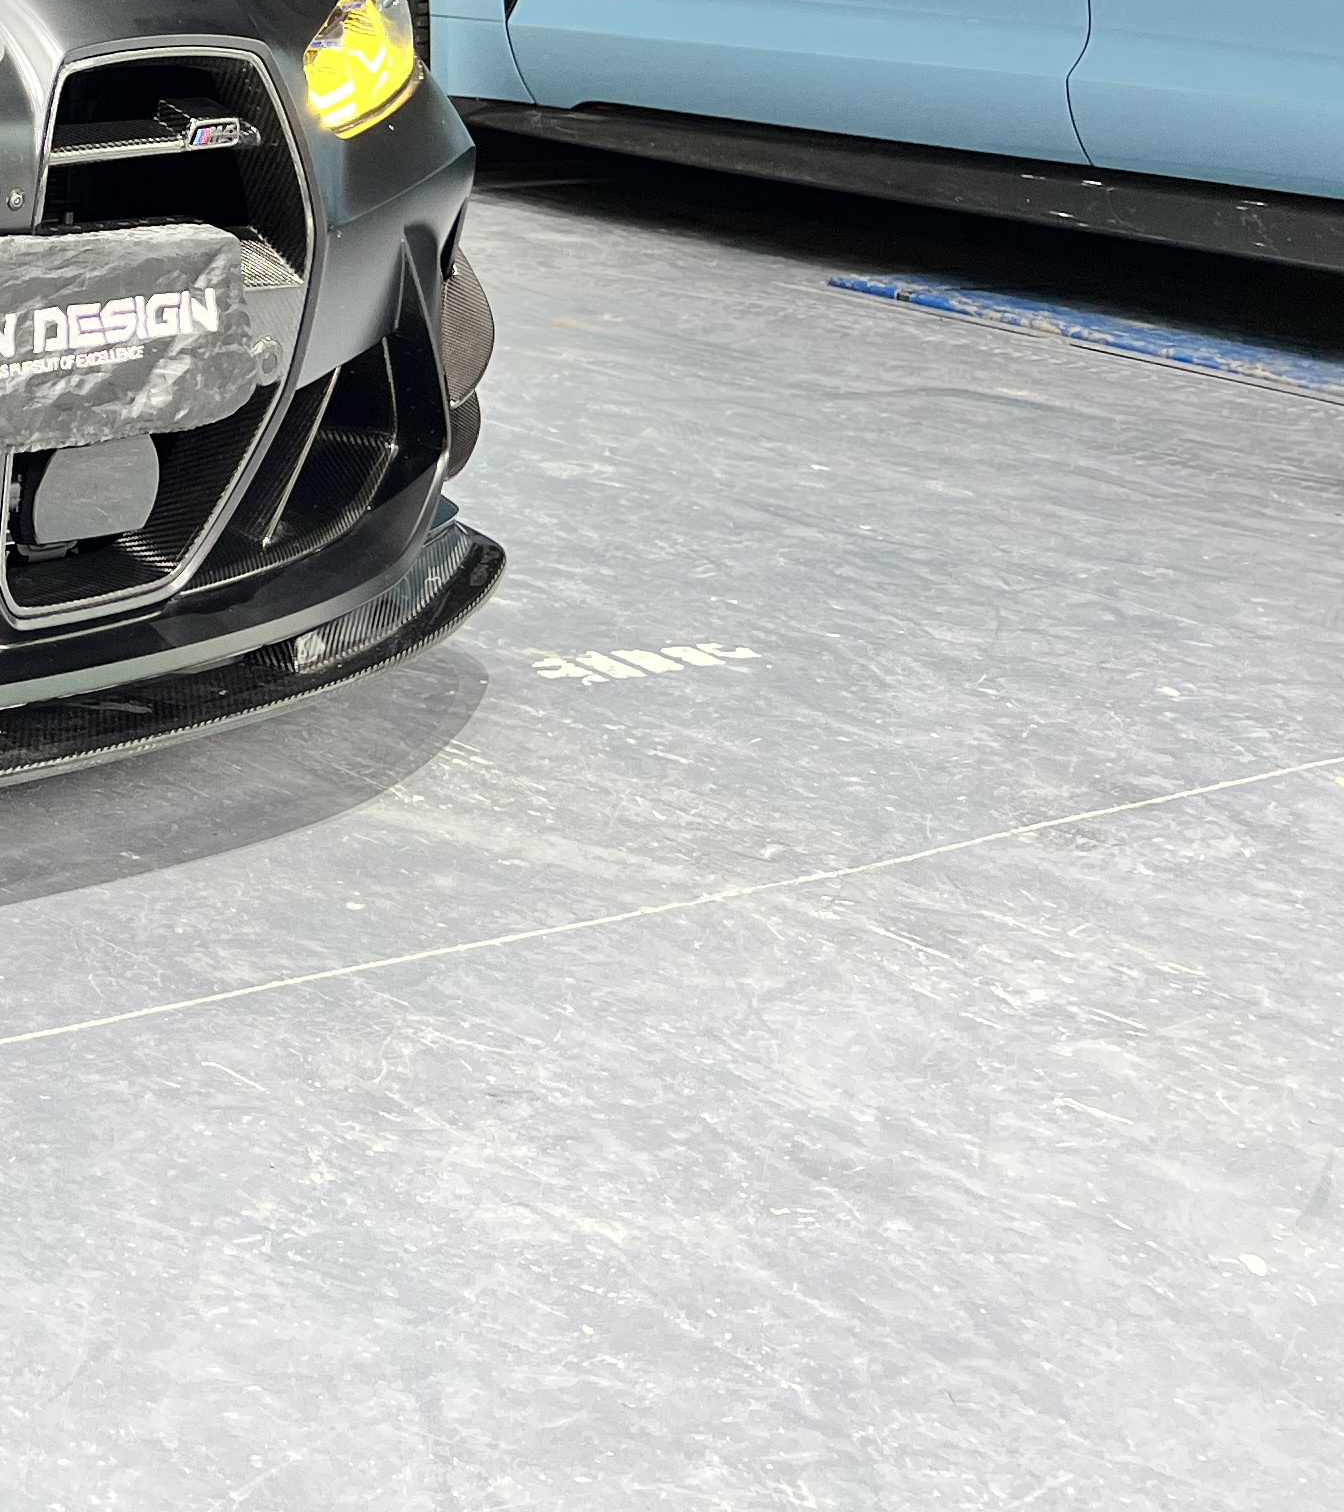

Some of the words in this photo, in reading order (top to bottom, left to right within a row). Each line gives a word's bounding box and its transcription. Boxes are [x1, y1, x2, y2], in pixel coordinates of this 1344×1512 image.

[32, 288, 219, 354] DESIGN
[10, 356, 59, 377] PURSUIT
[60, 354, 76, 370] OF
[76, 345, 145, 368] EXCELLENCE
